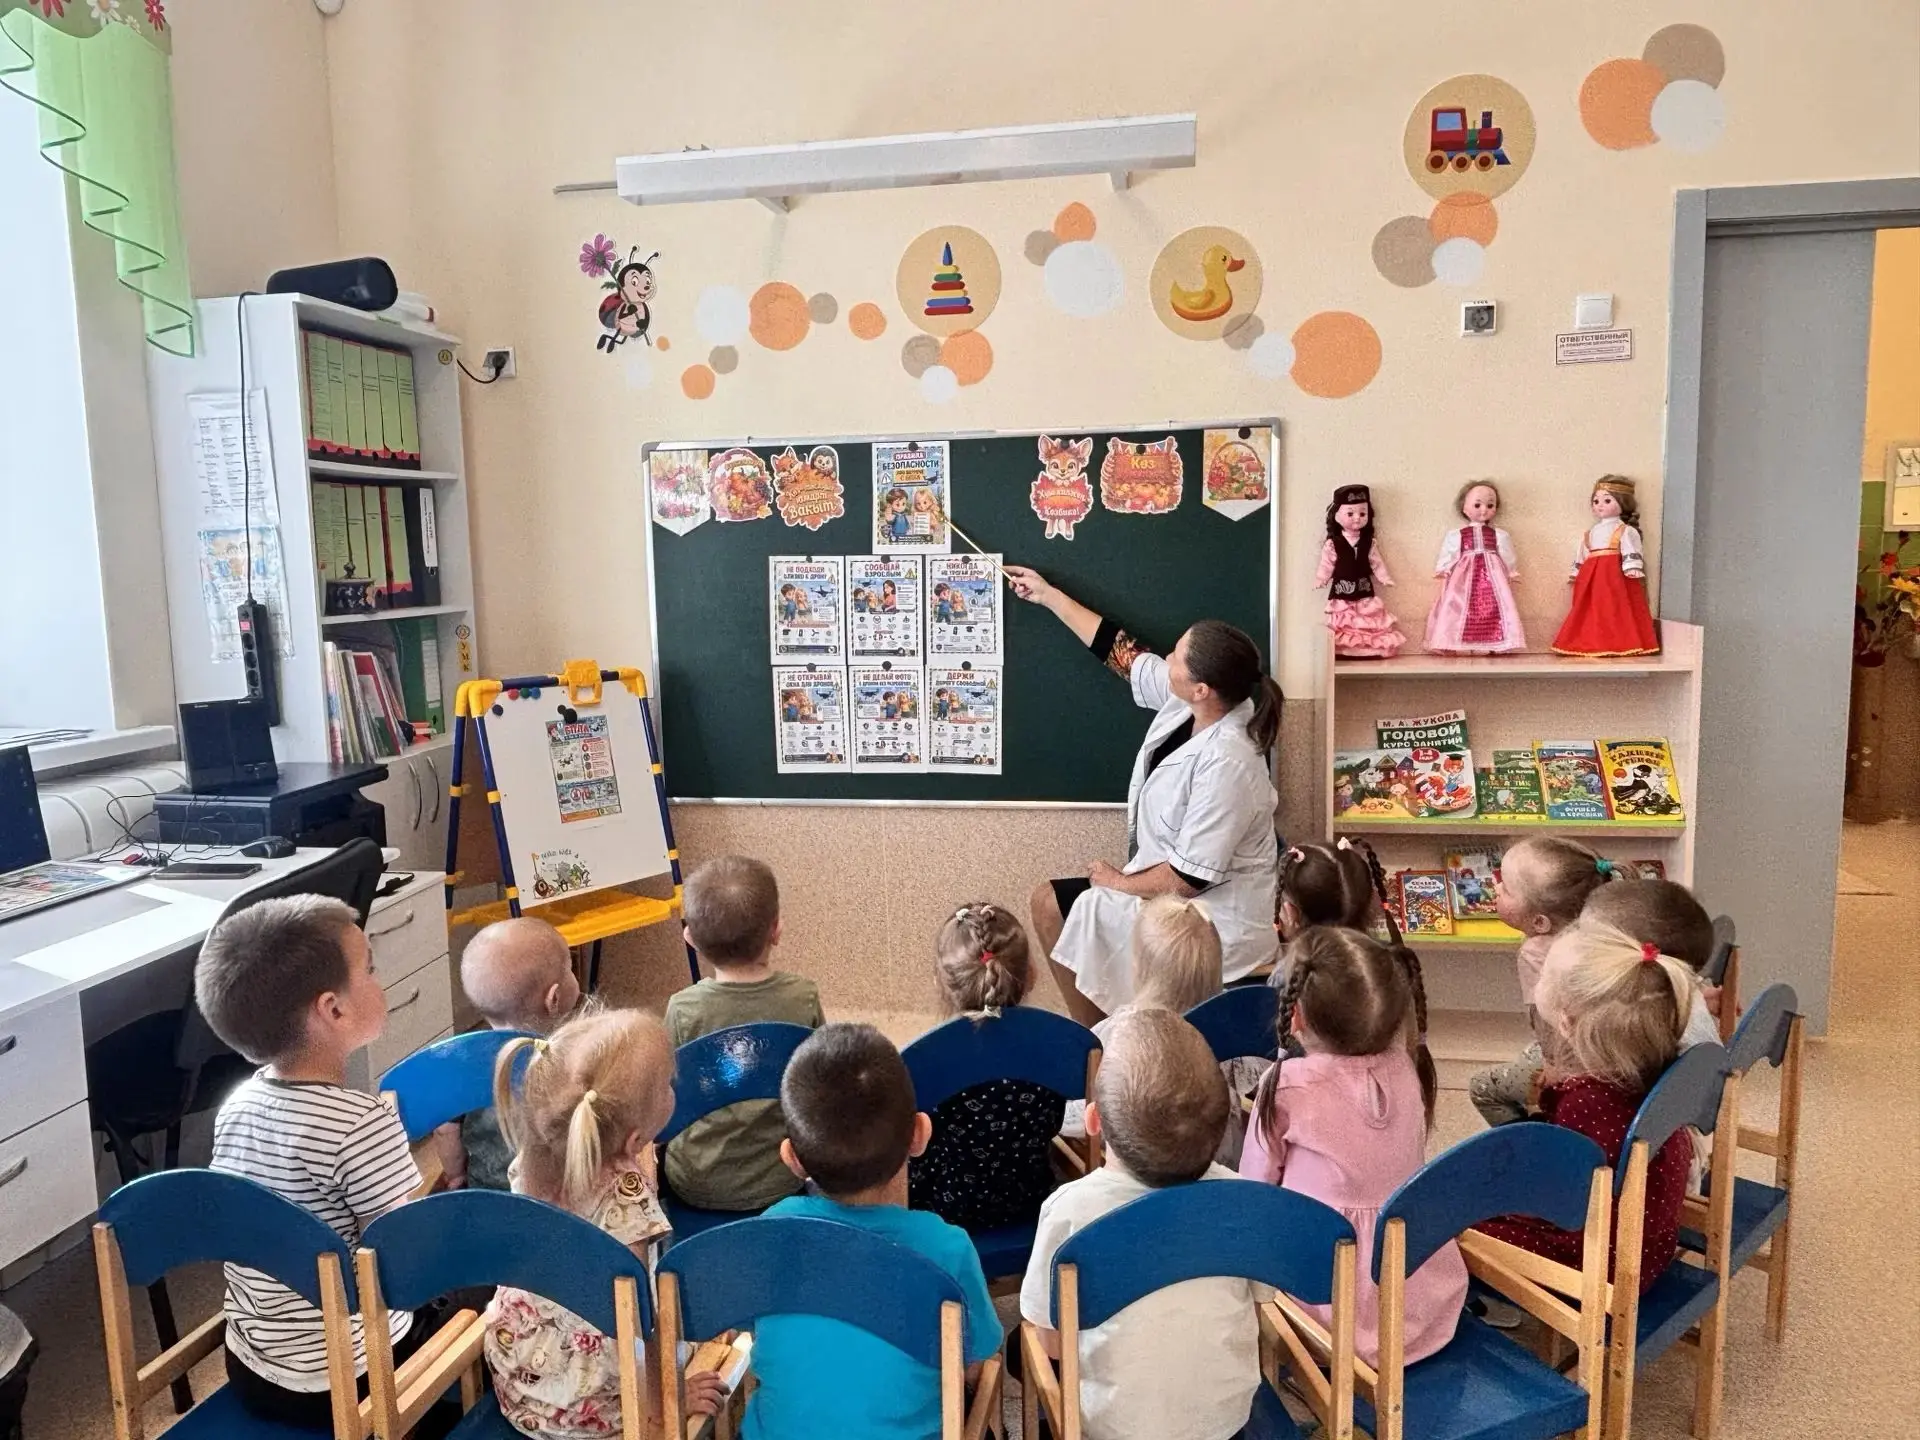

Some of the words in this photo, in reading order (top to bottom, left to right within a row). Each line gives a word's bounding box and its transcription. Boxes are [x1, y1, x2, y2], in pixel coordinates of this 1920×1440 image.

[882, 460, 939, 470] БЕЗОПАСНОСТИ
[946, 672, 975, 680] ДЕРЖИ
[1412, 712, 1460, 726] ЖУКОВА
[1382, 723, 1461, 741] ГОДОВОЙ
[1383, 741, 1411, 749] КУРС
[1413, 735, 1463, 748] ЗАНЯТИЙ
